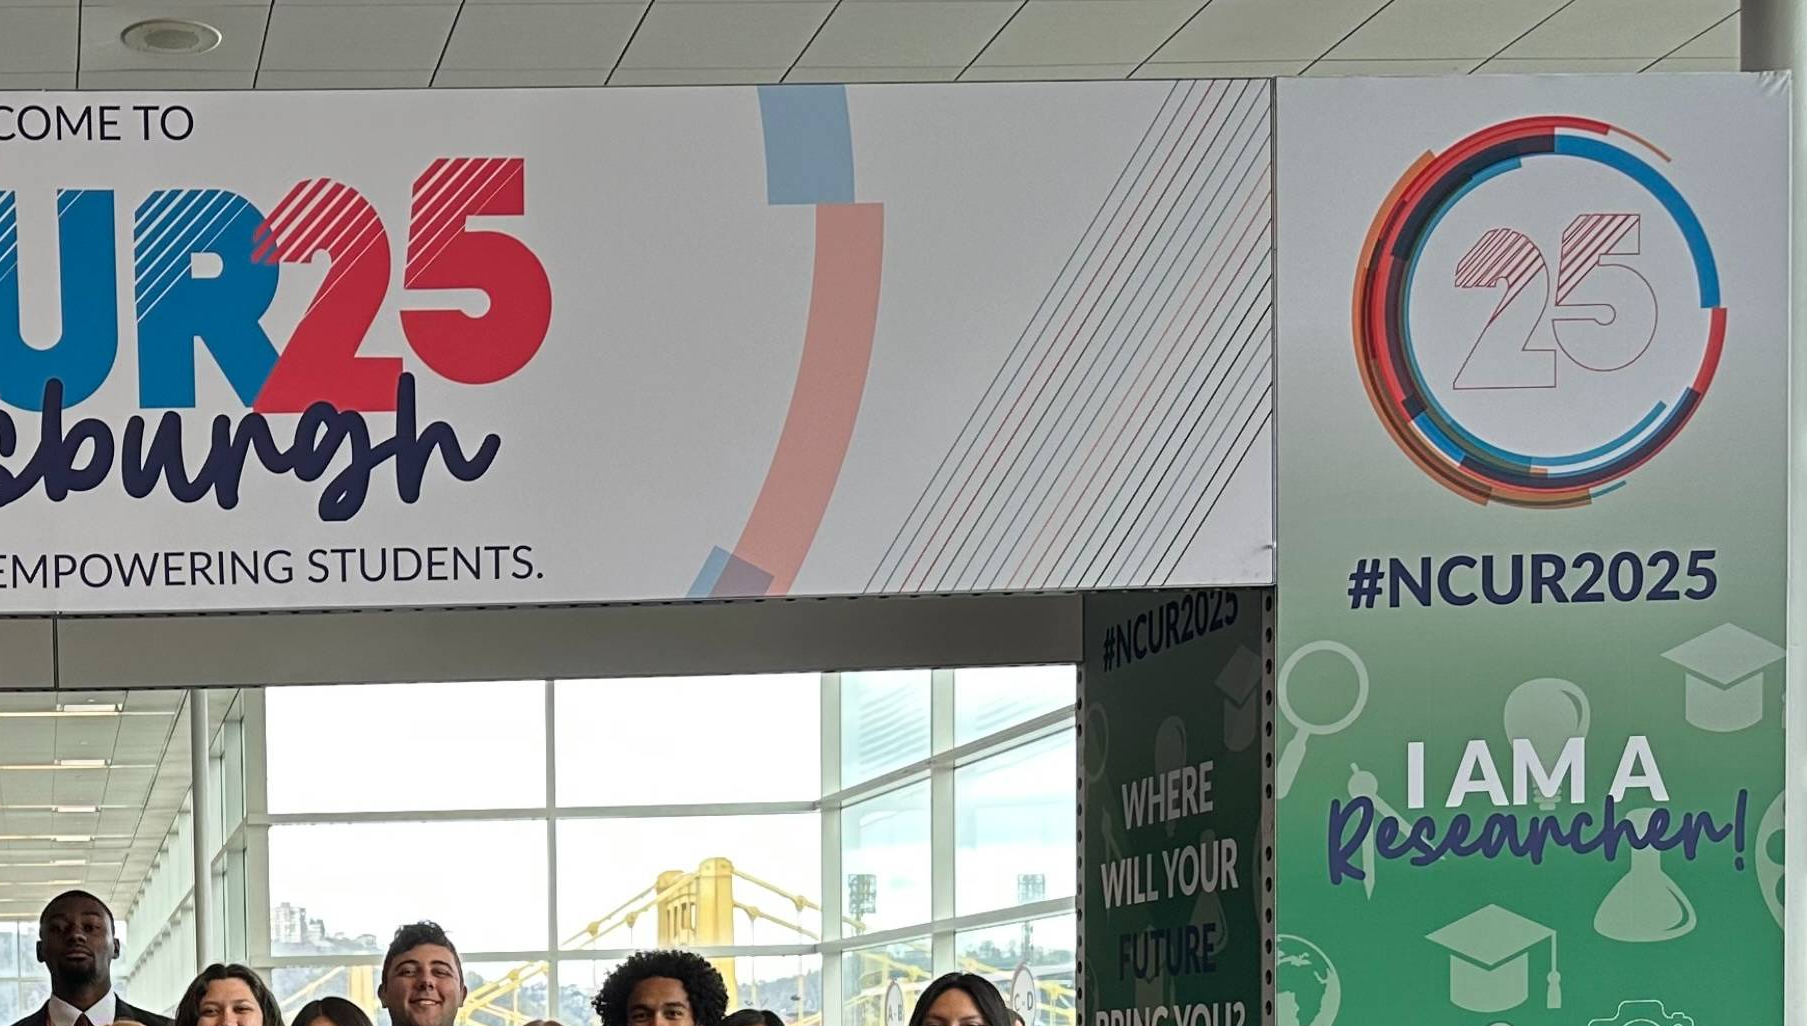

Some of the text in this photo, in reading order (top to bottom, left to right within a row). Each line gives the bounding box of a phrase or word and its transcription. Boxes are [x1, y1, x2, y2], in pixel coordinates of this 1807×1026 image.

[133, 103, 196, 142] TO
[1452, 213, 1658, 391] 25
[305, 544, 546, 587] STUDENTS.
[1346, 549, 1719, 610] #NCUR2025
[1102, 590, 1239, 673] #NCUR2025
[1120, 760, 1215, 831] WHERE
[1407, 735, 1671, 810] I AM A
[1100, 837, 1240, 910] WILL YOUR
[1326, 788, 1750, 887] Researcher!
[1118, 922, 1217, 982] FUTURE
